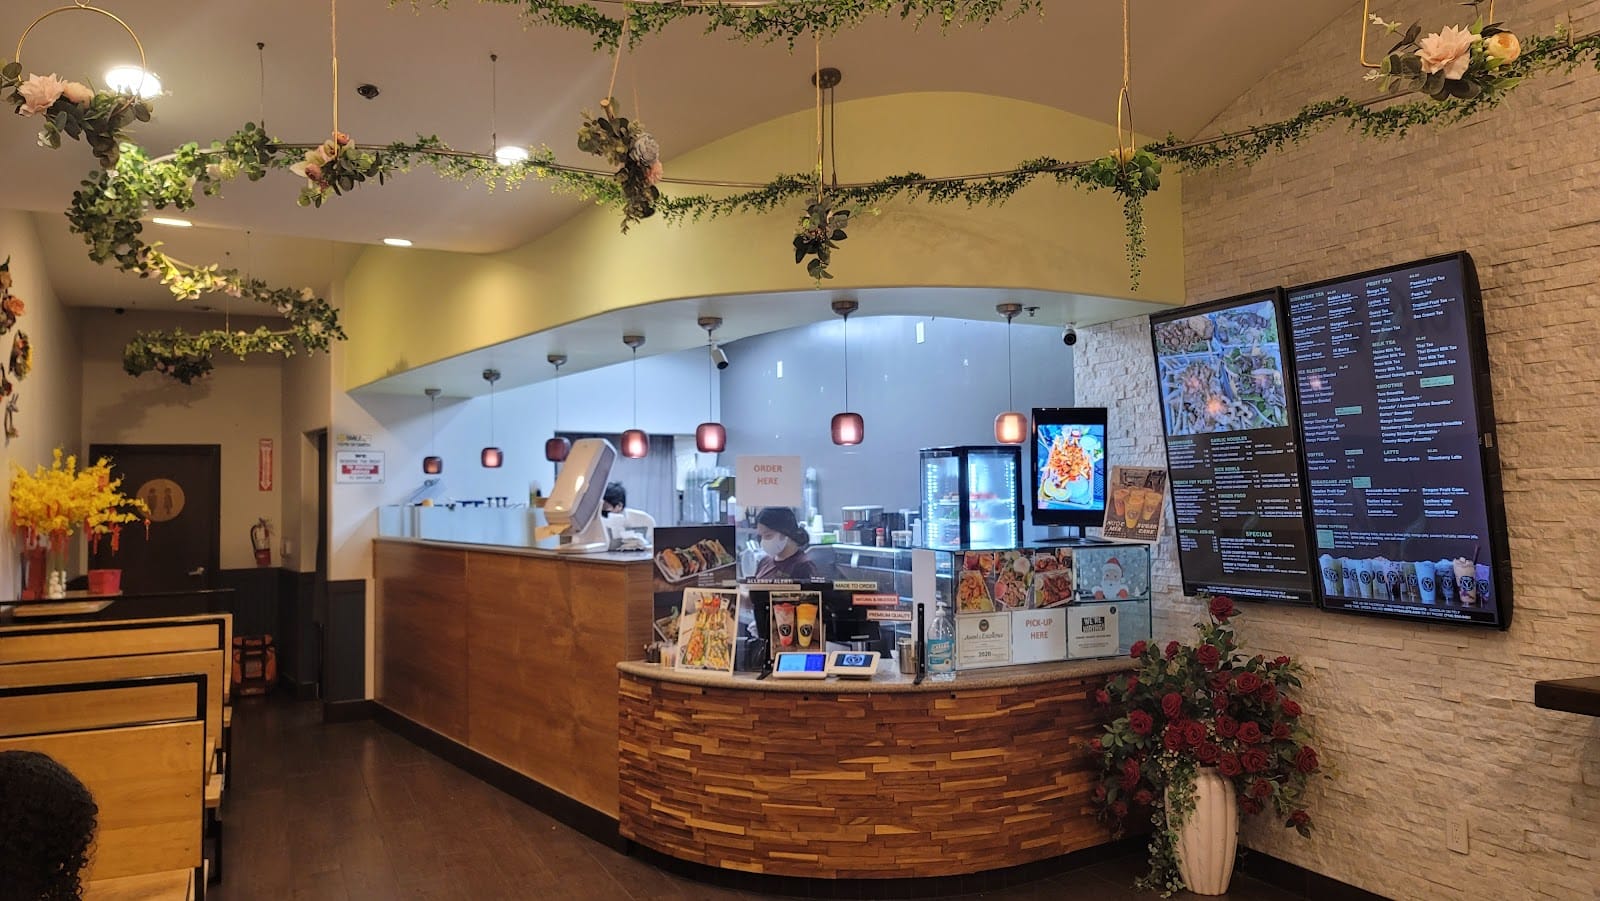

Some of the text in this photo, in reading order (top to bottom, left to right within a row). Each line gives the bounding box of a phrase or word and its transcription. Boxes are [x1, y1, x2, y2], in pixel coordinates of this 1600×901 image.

[754, 464, 782, 472] ORDER
[757, 477, 779, 486] HERE
[1025, 618, 1053, 628] PICK-UP
[1030, 631, 1049, 640] HERE
